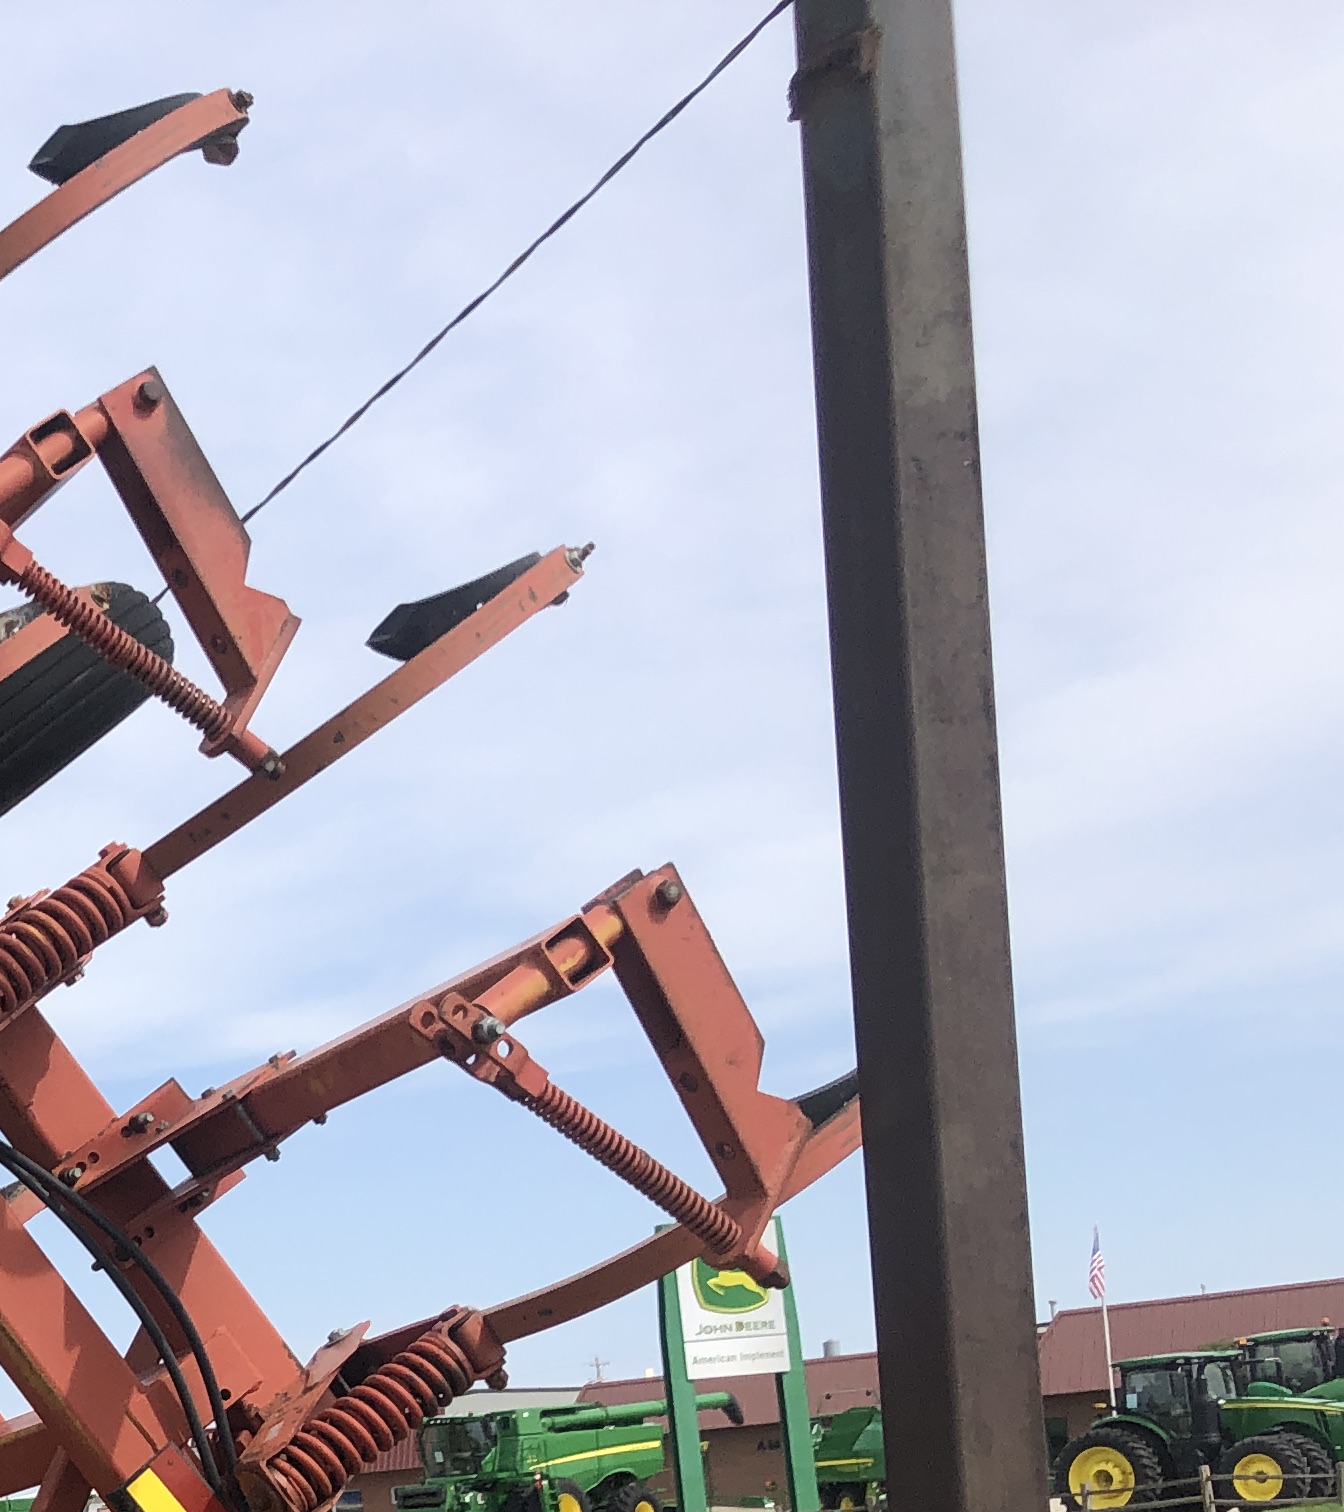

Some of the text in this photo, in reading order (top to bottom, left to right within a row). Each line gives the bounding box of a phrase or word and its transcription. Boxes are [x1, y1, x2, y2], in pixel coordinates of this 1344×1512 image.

[695, 1319, 776, 1336] JOHN DEERE
[692, 1349, 785, 1366] American Implement
